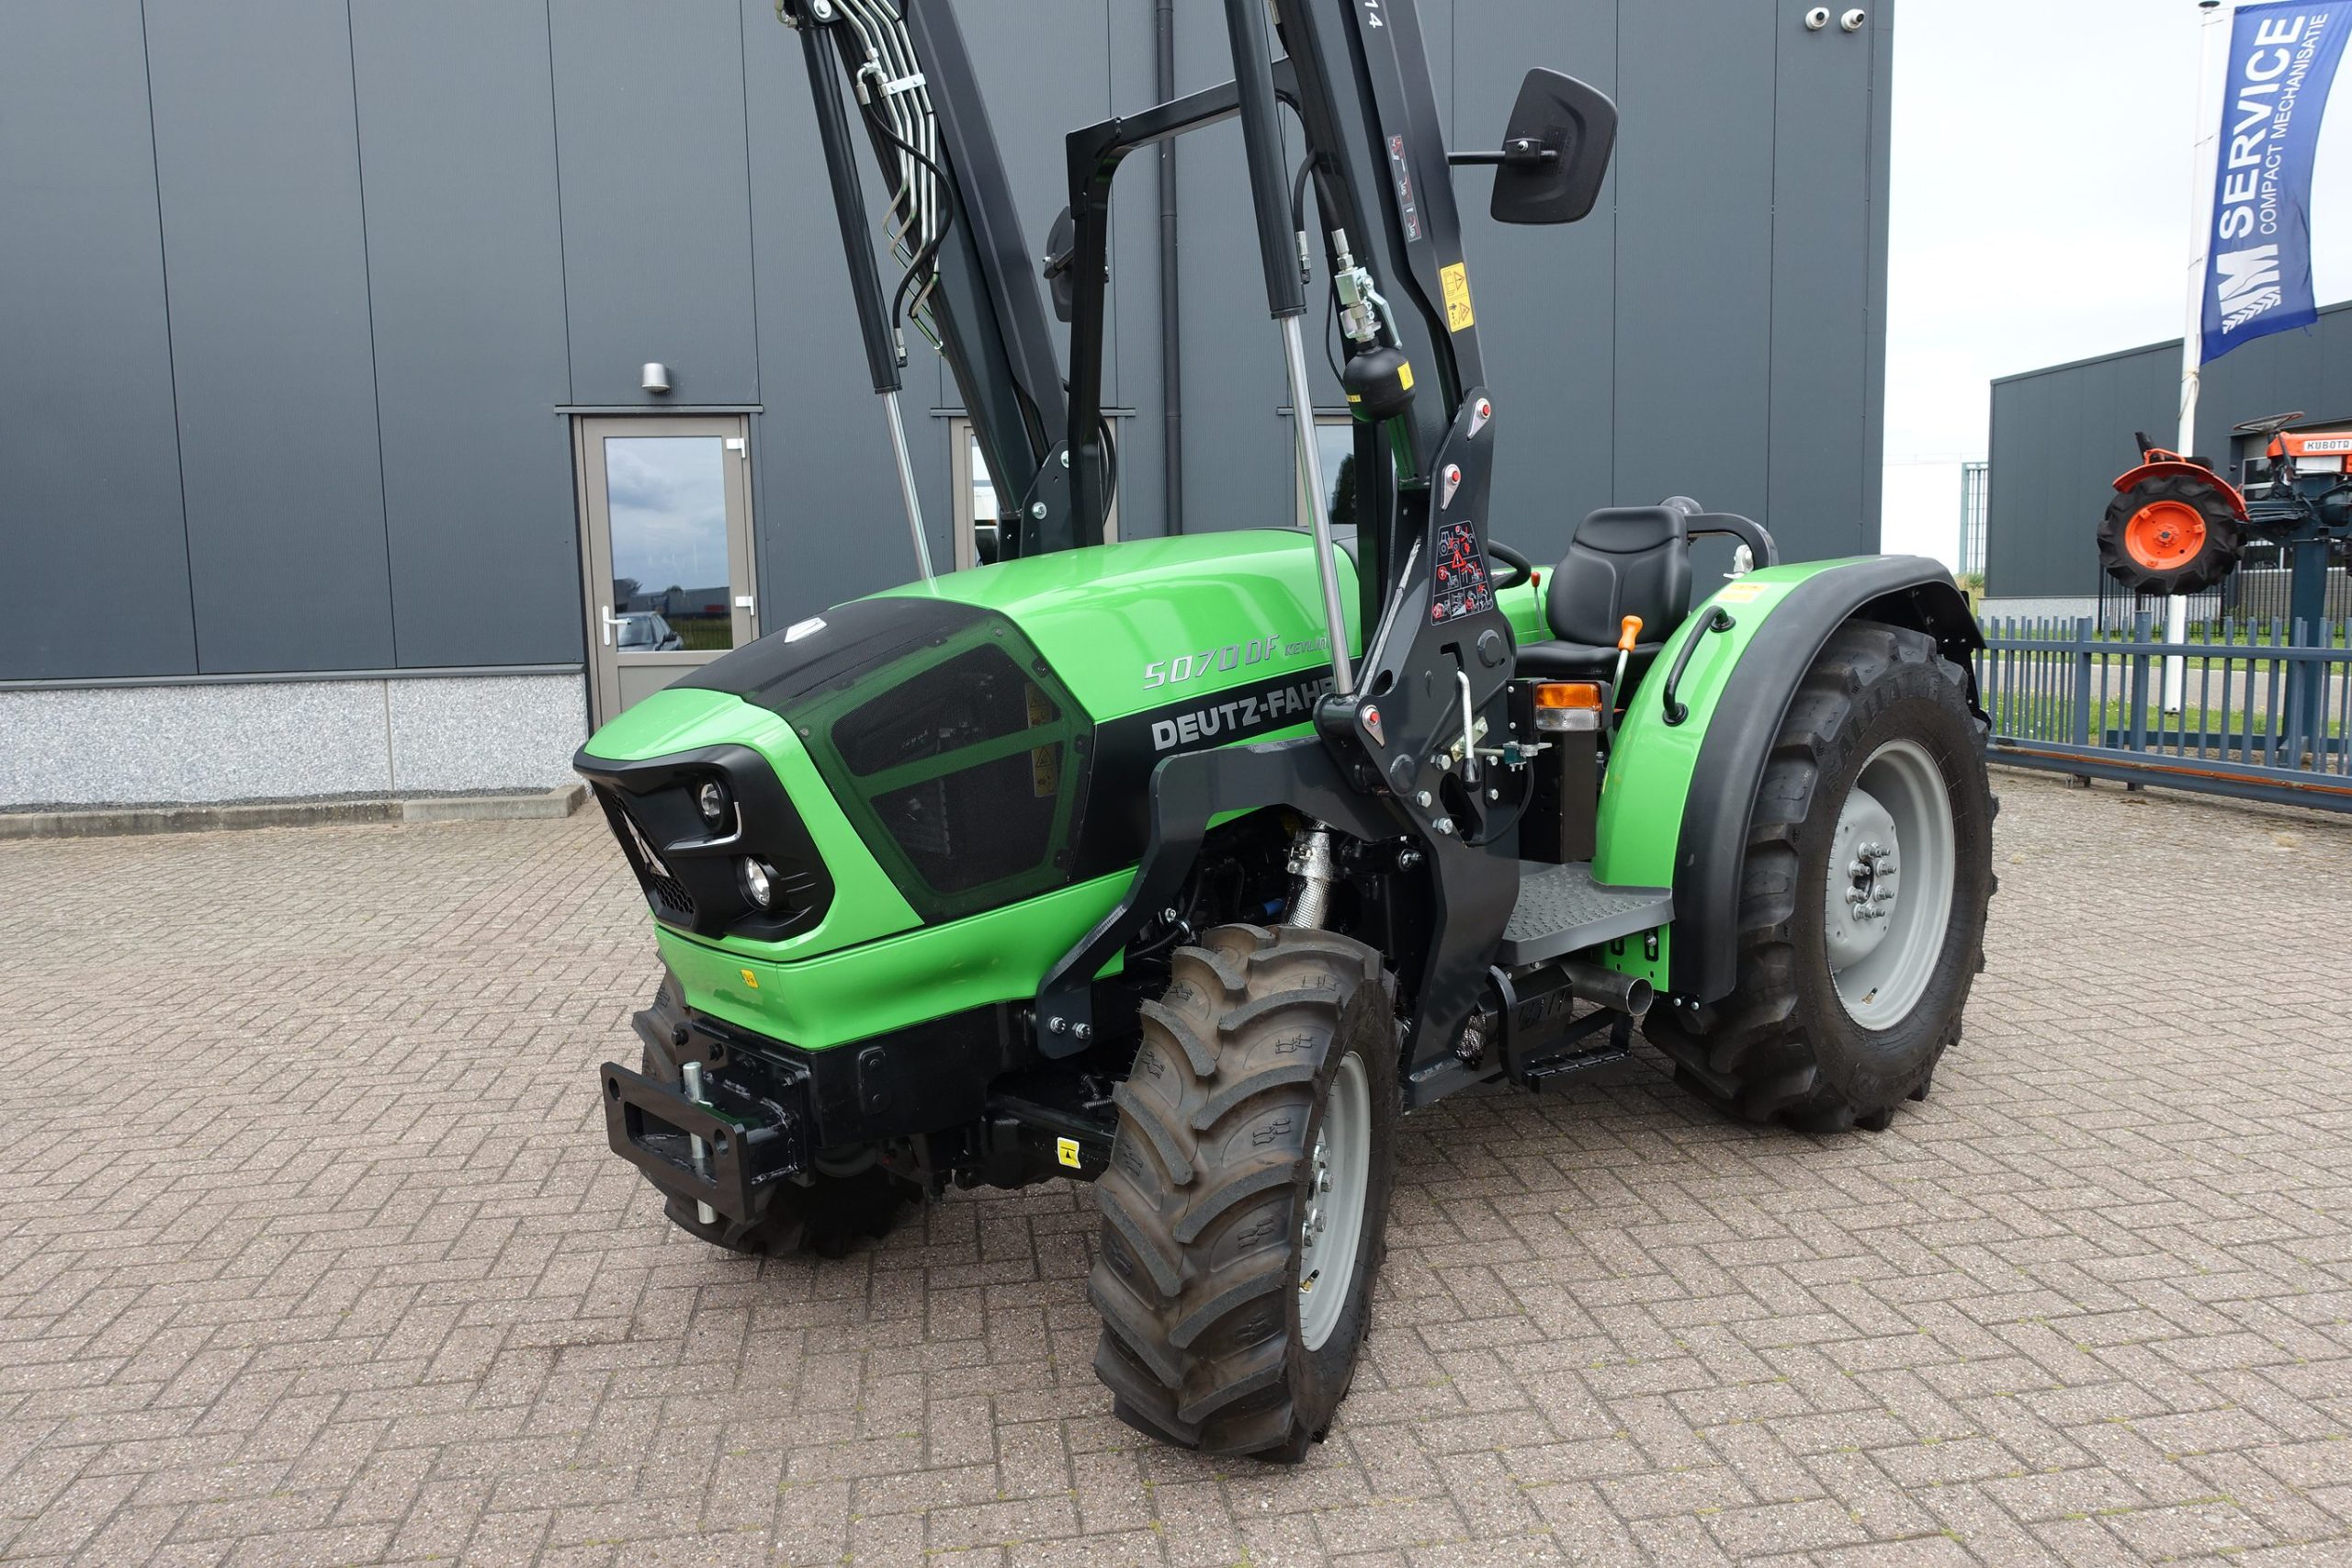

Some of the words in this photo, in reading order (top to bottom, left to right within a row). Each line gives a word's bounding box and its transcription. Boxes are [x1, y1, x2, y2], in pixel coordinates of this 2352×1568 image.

[2270, 13, 2329, 140] MECHANISATIE
[2219, 15, 2305, 241] SERVICE
[2259, 144, 2285, 235] COMPACT
[2307, 440, 2350, 450] KUBOTA
[1143, 644, 1240, 690] 5070
[1244, 634, 1281, 666] DF
[1284, 637, 1329, 657] KEYLIN
